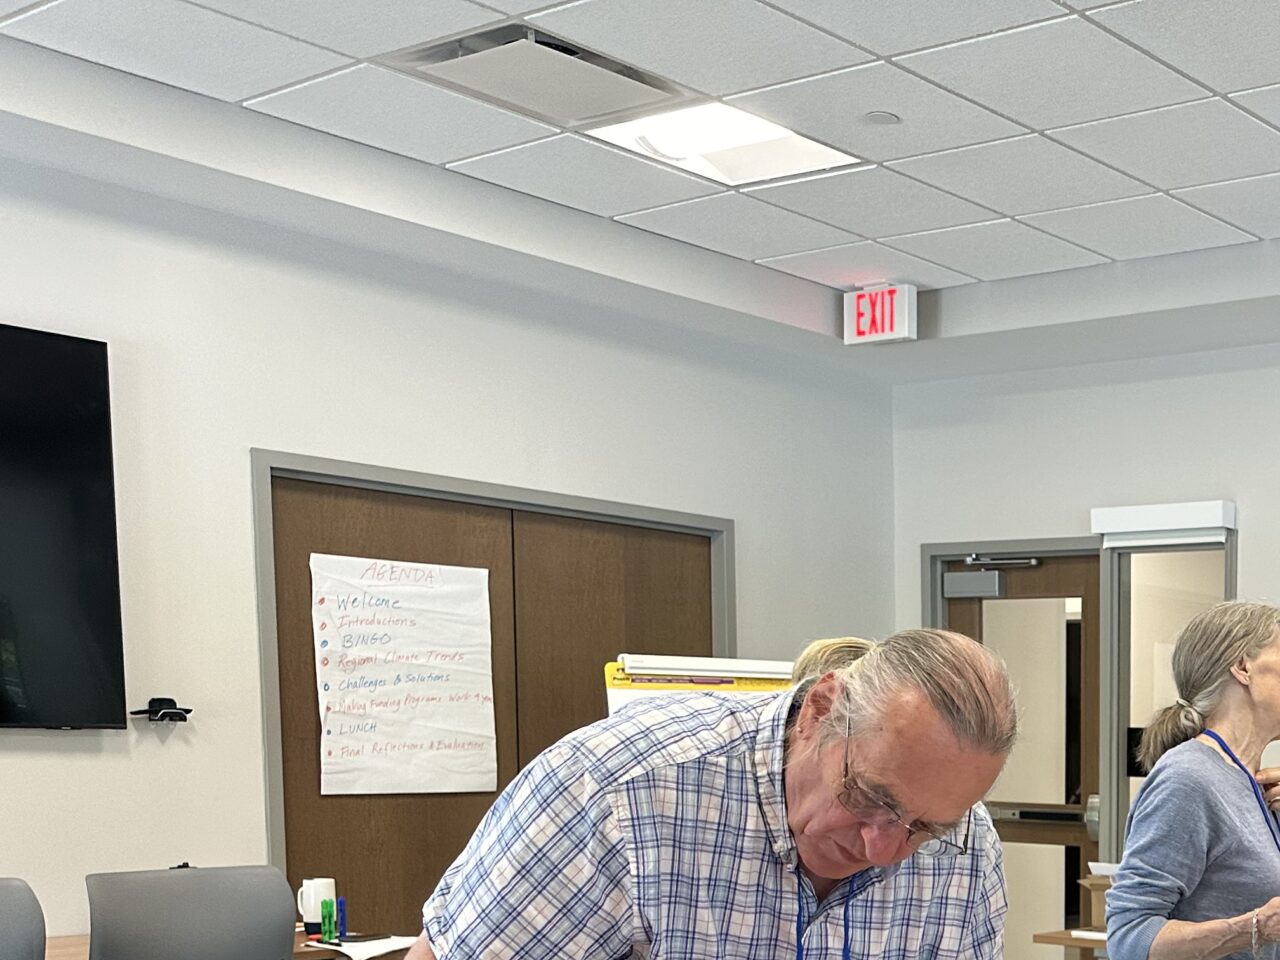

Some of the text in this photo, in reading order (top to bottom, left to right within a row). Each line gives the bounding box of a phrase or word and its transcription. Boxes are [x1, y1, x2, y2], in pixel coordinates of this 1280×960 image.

[856, 289, 897, 337] EXIT
[360, 562, 435, 585] AGENDA
[336, 593, 401, 609] Welcome
[338, 615, 417, 627] Introductions
[342, 633, 391, 649] BINGO
[338, 654, 378, 674] Regional
[339, 679, 386, 692] Challenges
[339, 723, 376, 736] LUNCH
